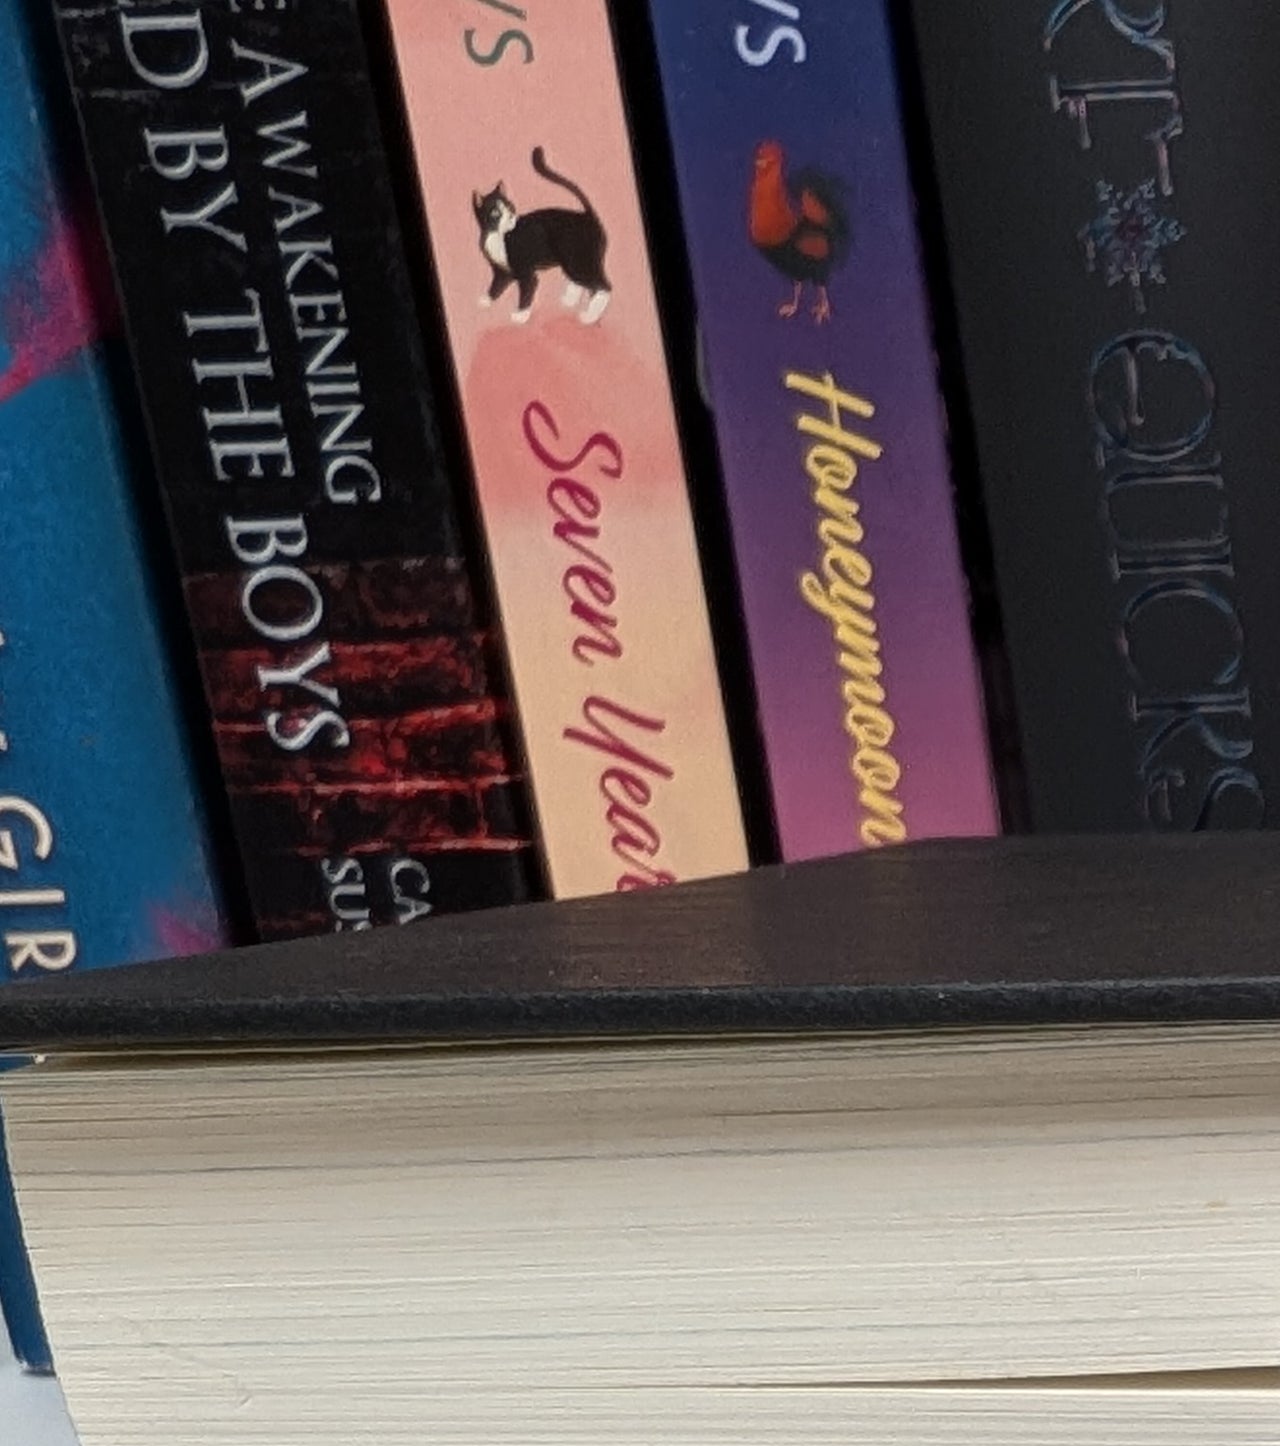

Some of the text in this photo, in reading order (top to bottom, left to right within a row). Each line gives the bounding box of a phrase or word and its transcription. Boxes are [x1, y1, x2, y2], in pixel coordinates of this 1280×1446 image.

[143, 124, 249, 253] BY
[229, 37, 384, 507] AWAKENING
[182, 288, 297, 481] THE
[224, 513, 349, 753] BOYS
[521, 399, 624, 664] Seven
[782, 368, 910, 849] Honeymoon
[0, 795, 78, 973] GIR
[320, 857, 374, 932] SU
